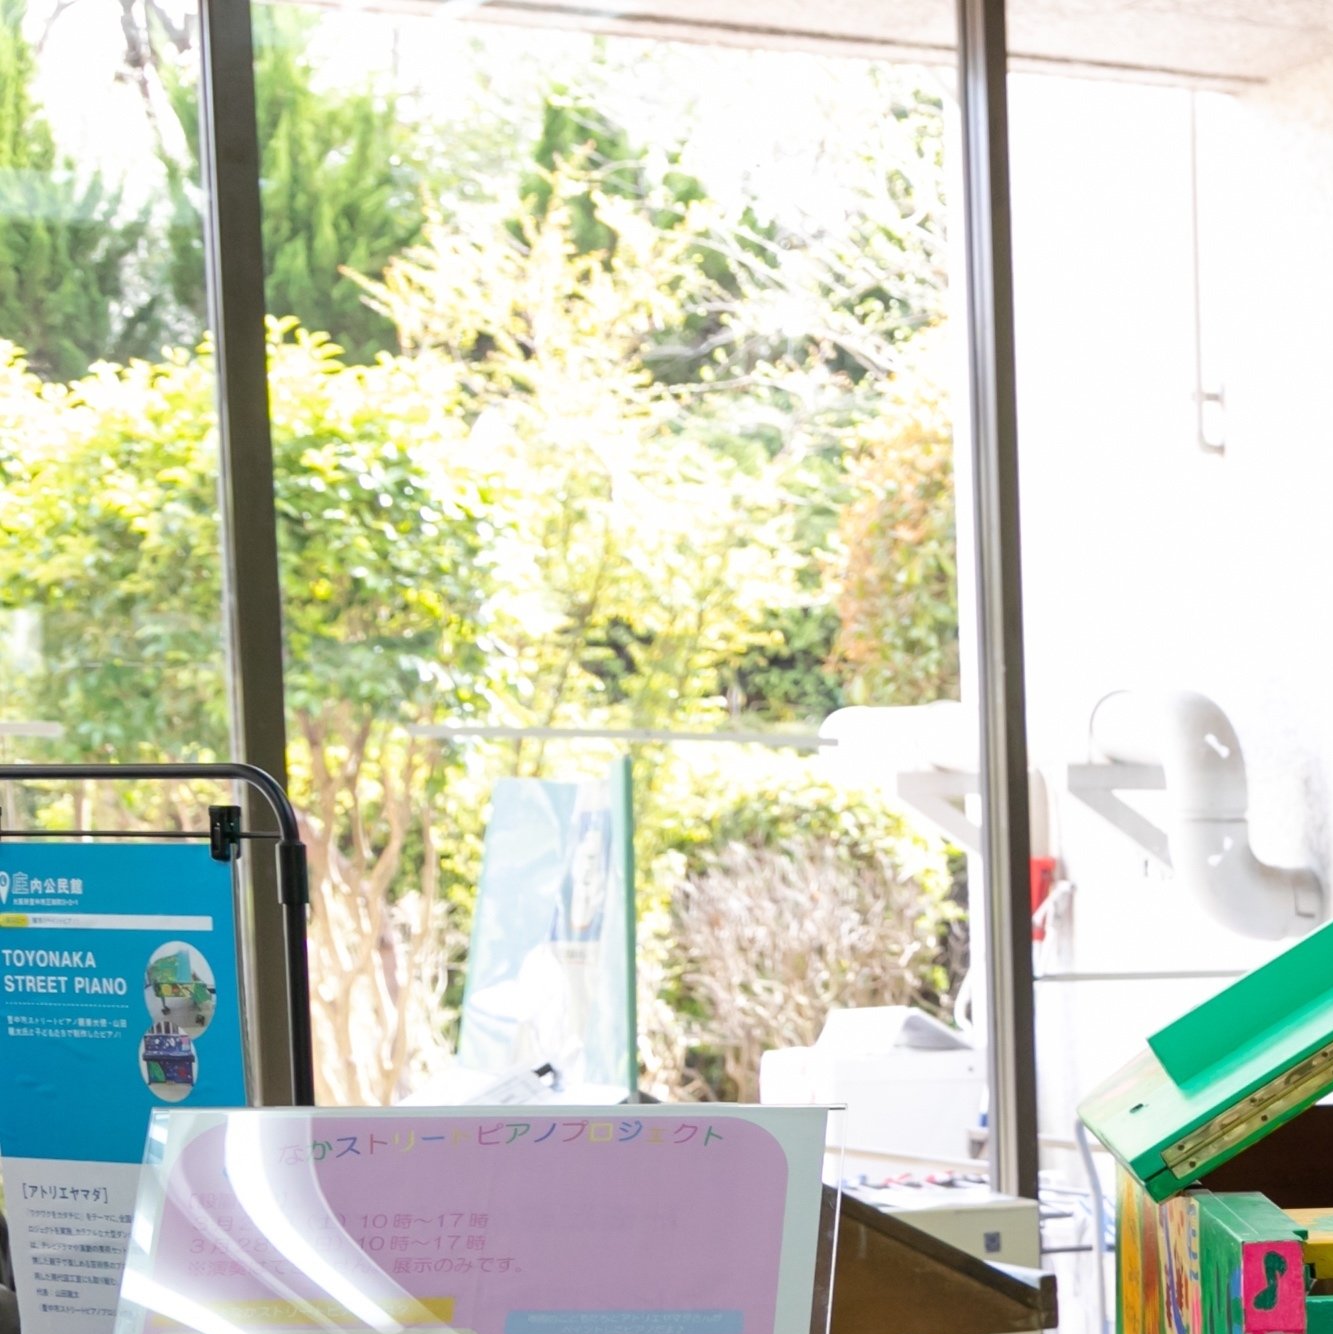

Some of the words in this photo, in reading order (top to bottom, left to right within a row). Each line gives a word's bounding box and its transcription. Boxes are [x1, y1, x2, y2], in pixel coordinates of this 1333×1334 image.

[3, 949, 97, 968] TOYONAKA
[4, 974, 68, 993] STREET
[74, 977, 127, 996] PIANO
